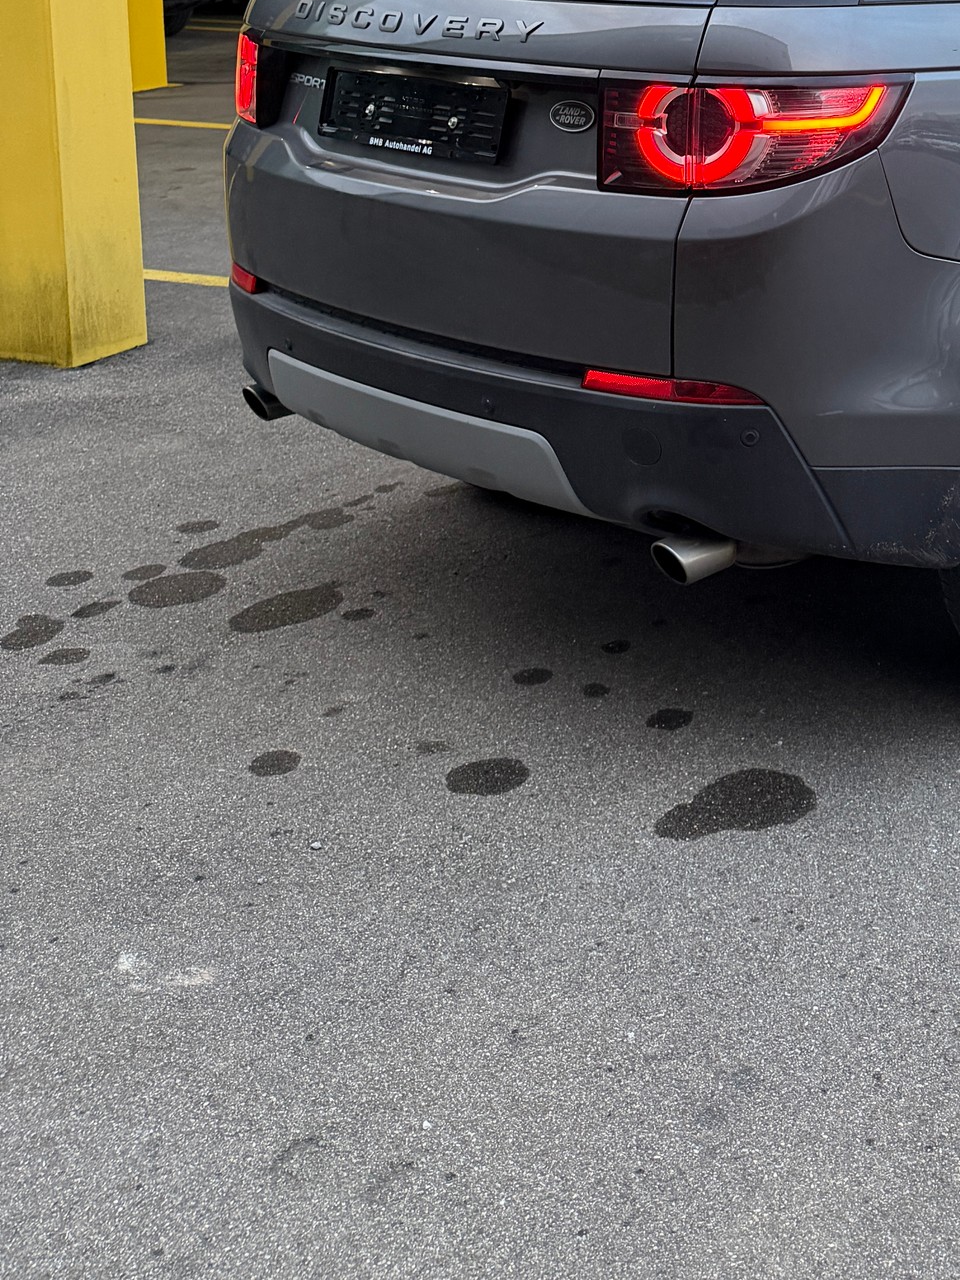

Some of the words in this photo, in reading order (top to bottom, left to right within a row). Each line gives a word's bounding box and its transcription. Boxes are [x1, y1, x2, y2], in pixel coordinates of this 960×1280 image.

[290, 72, 326, 90] SPORT
[558, 106, 581, 116] LAND
[559, 114, 586, 125] ROVER
[369, 136, 384, 147] BMB
[384, 139, 422, 153] Autohandel
[421, 145, 433, 155] AG
